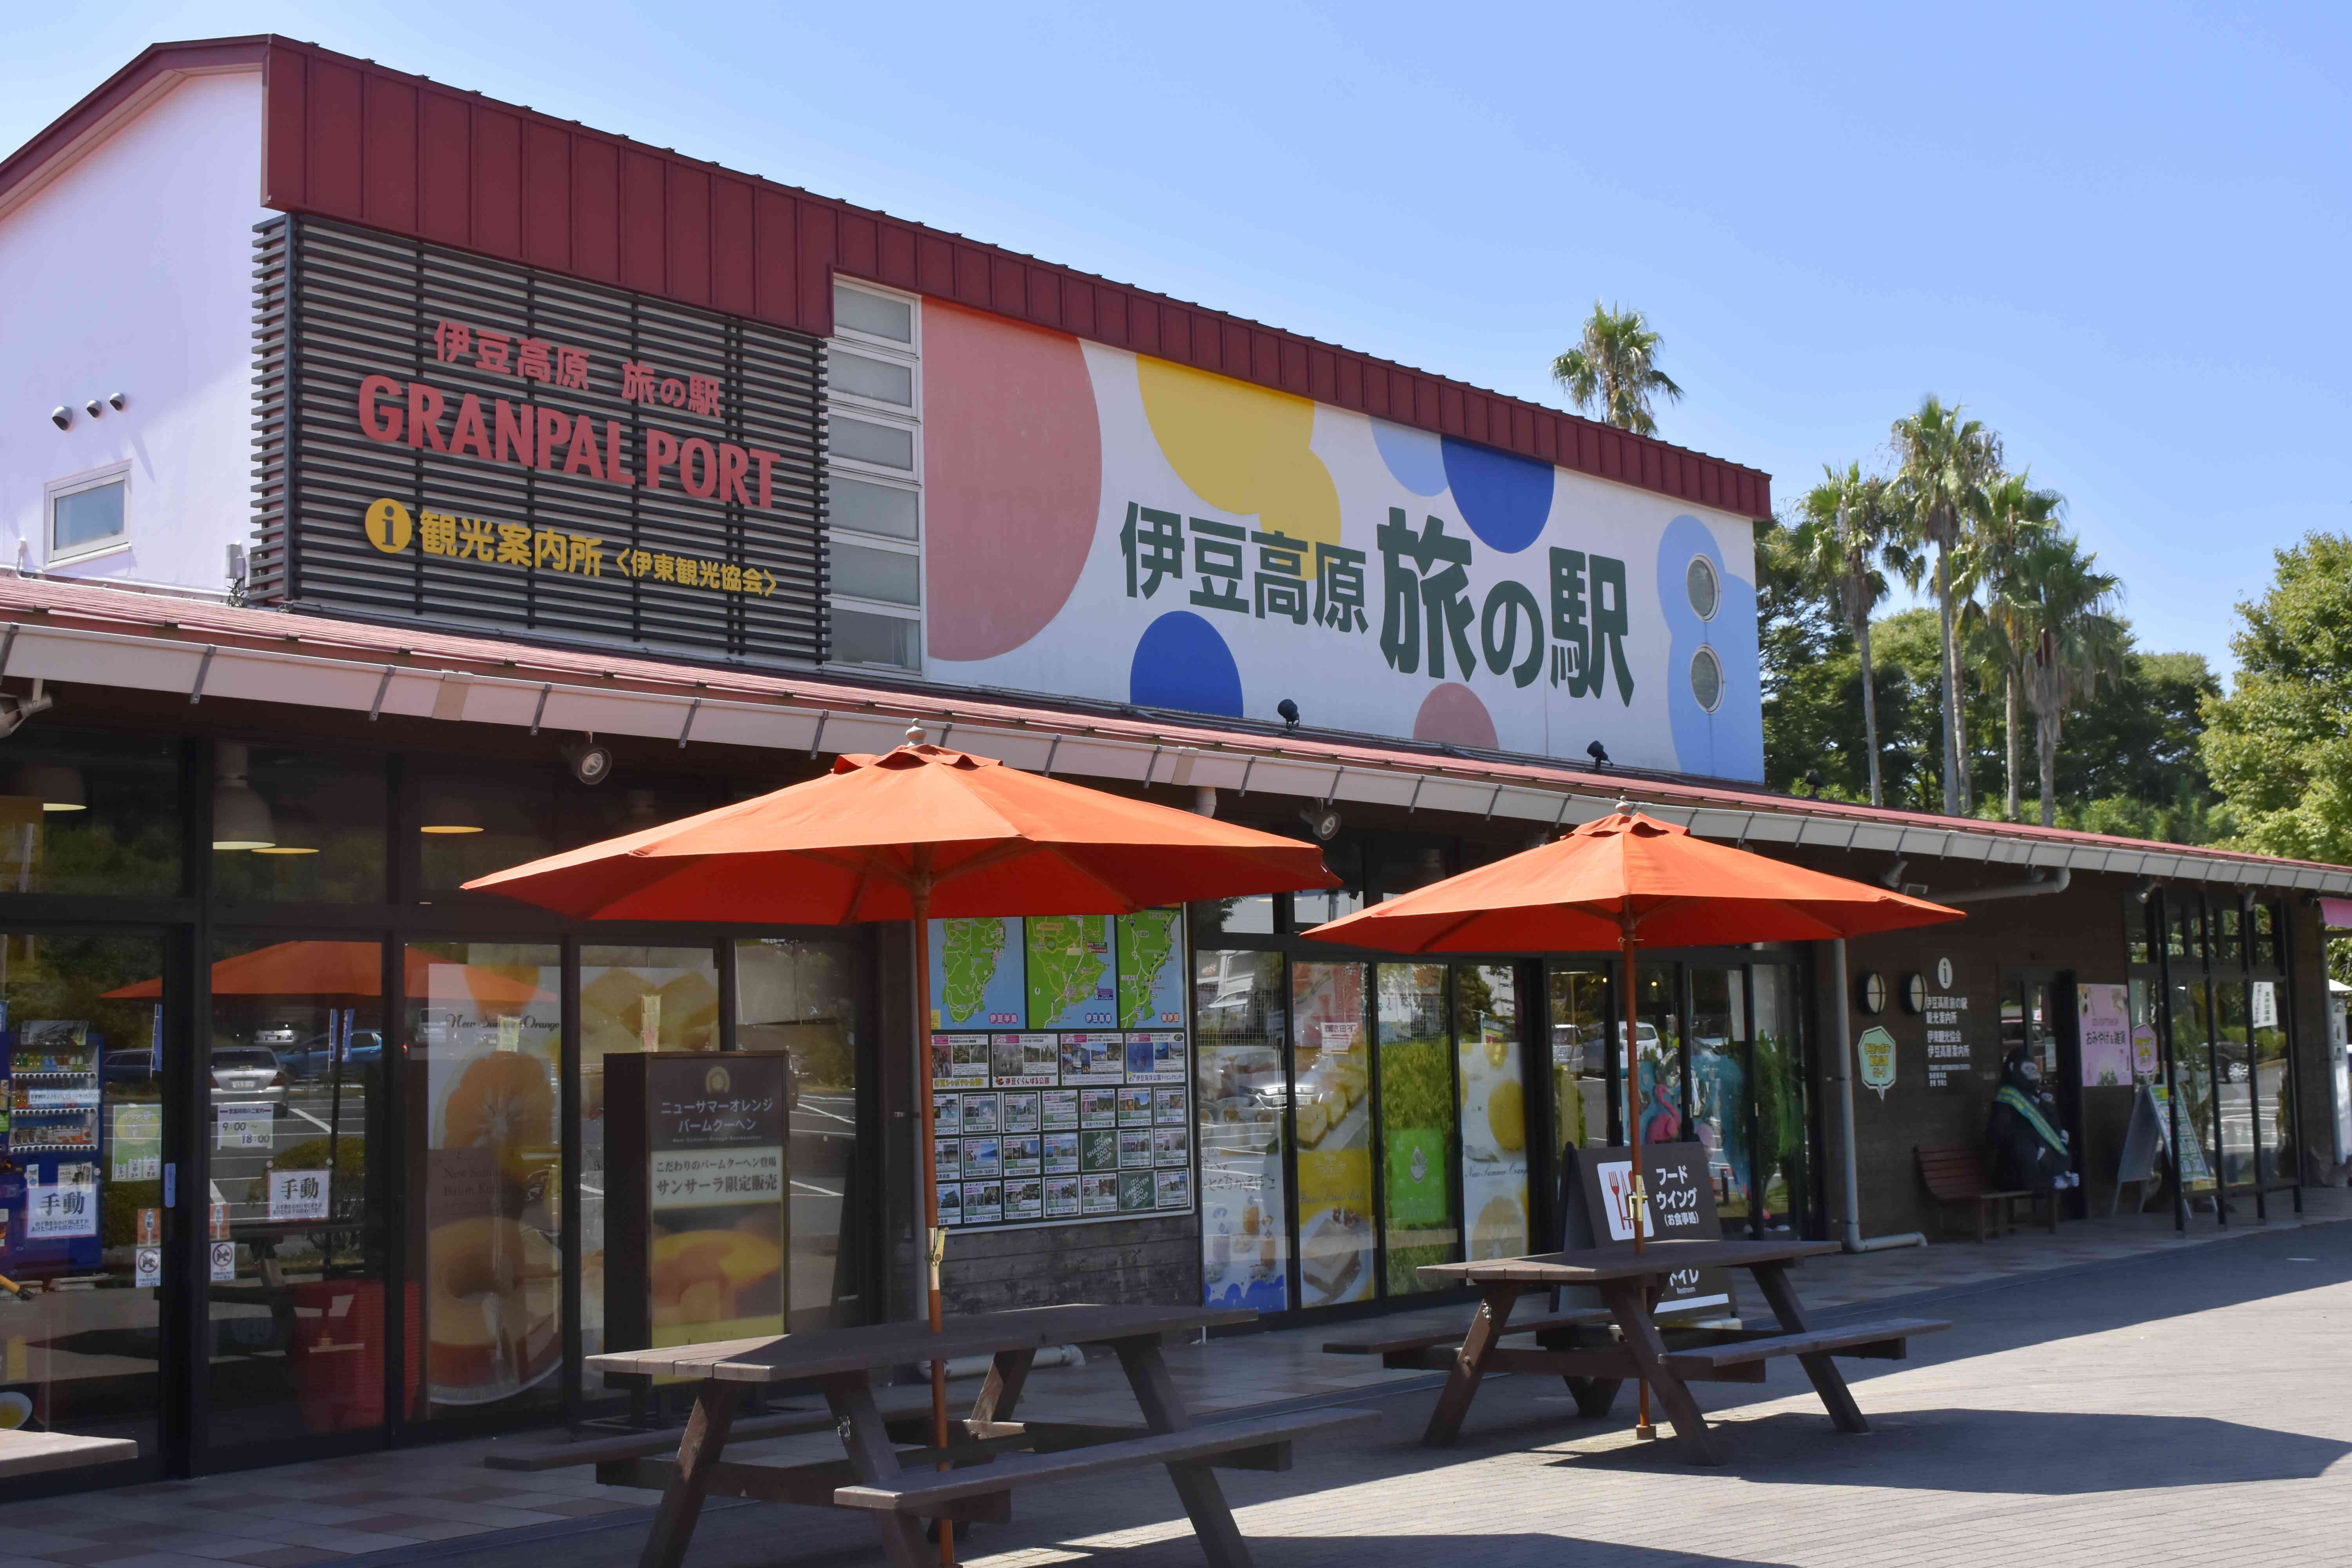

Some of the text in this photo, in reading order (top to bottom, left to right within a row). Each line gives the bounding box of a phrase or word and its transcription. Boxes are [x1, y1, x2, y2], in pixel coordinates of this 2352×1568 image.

[434, 319, 721, 417] 伊豆高原 旅の駅
[359, 374, 780, 508] GRANPAL PORT
[419, 510, 603, 577] 観光案内所
[524, 1015, 560, 1031] Orange
[989, 1013, 1018, 1024] 伊豆半島
[1086, 1013, 1112, 1023] 伊豆高原
[1161, 1013, 1180, 1023] 東伊豆
[1926, 1012, 1957, 1024] 観光案内所
[1927, 1030, 1961, 1043] 伊東観光協会
[1928, 1045, 1969, 1058] 伊豆高原案内所
[661, 1098, 772, 1114] ニューサマーオレンジ
[223, 1122, 246, 1131] 9:00
[679, 1118, 756, 1132] バームクーヘン
[242, 1135, 270, 1143] 18:00
[1094, 1137, 1103, 1146] IZU
[1086, 1137, 1112, 1158] SHABOTEN
[1096, 1150, 1107, 1160] ZOO
[657, 1156, 777, 1172] こだわりのバームクーヘン登場
[1095, 1152, 1111, 1167] GROUP
[1508, 1163, 1528, 1178] Orang
[1656, 1165, 1688, 1186] フード
[281, 1177, 319, 1200] 手動
[657, 1174, 778, 1196] サンサーラ限定販売
[1125, 1177, 1149, 1198] SHABOTEN
[1131, 1177, 1139, 1186] IZU
[1132, 1192, 1148, 1206] GROUP
[1134, 1189, 1143, 1199] ZOO
[1656, 1187, 1697, 1210] ウイング
[40, 1191, 85, 1216] 手動
